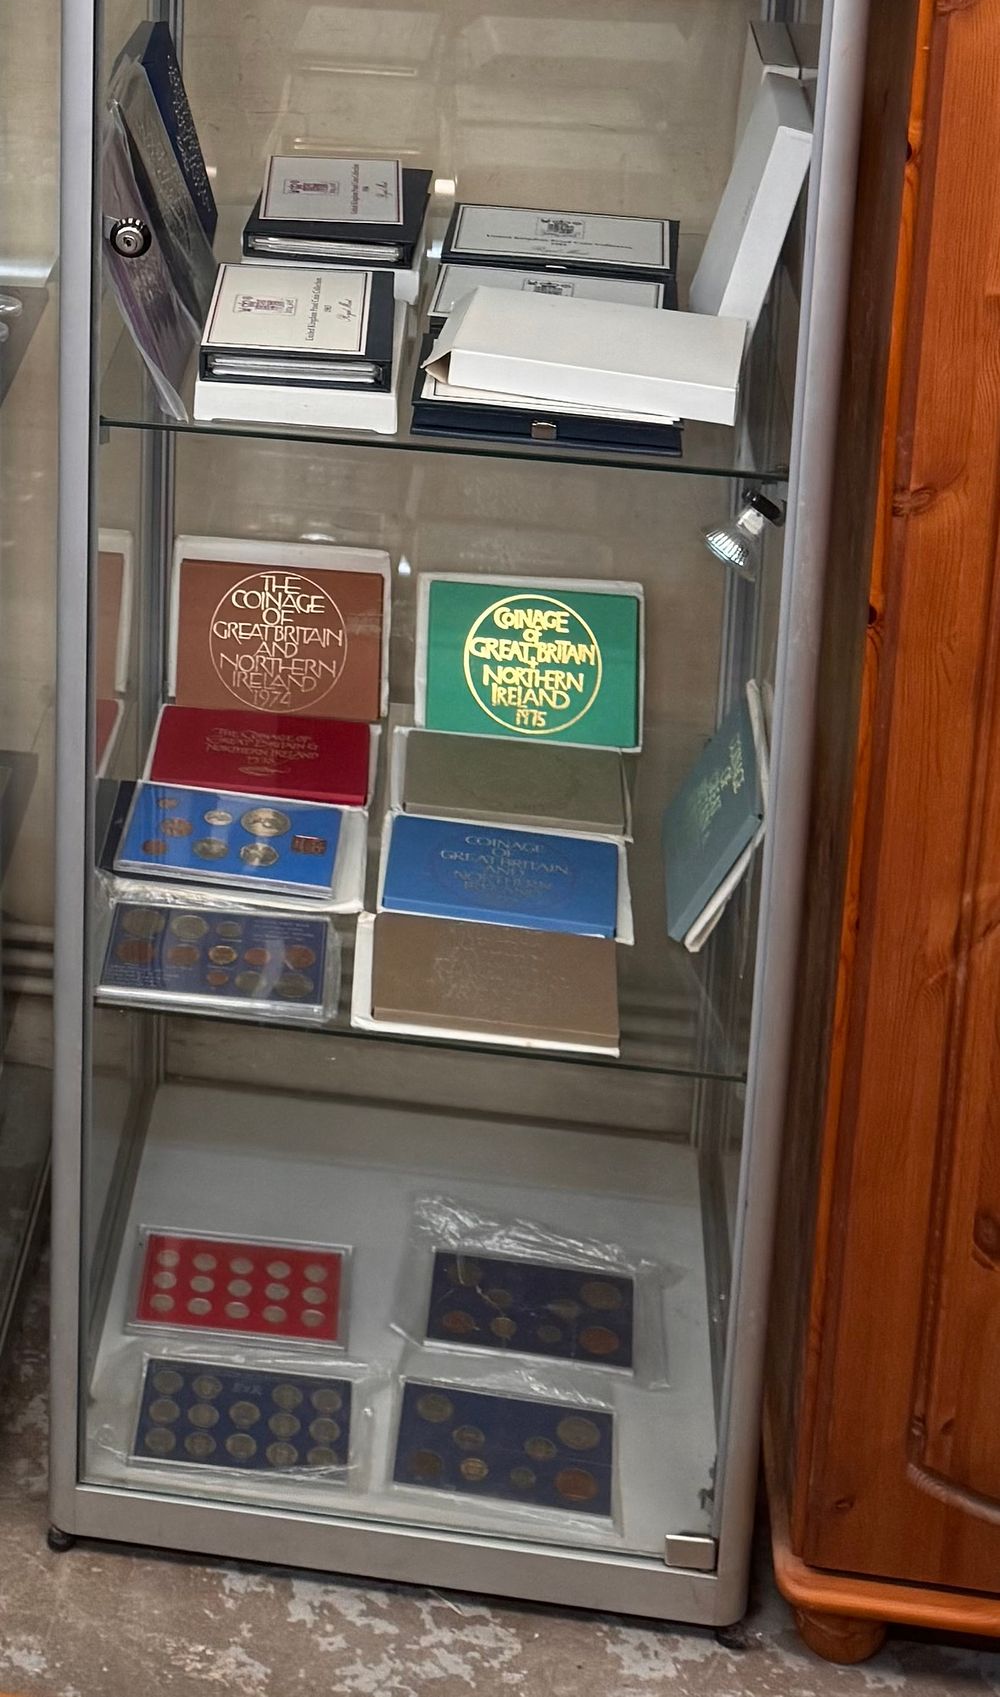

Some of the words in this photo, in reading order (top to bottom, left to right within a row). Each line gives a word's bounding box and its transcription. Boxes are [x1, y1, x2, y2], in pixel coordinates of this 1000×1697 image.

[260, 575, 301, 595] THE
[231, 590, 325, 613] COINAGE
[262, 608, 295, 625] OF
[493, 607, 570, 634] COINAGE
[523, 628, 542, 644] OF
[254, 642, 298, 658] AND
[468, 637, 537, 664] GREAT
[537, 640, 596, 665] BRITAIN
[220, 653, 336, 679] NORTHERN
[232, 670, 317, 693] IRELAND
[482, 664, 585, 693] NORTHERN
[253, 689, 291, 707] 1974
[491, 683, 571, 709] IRELAND
[516, 708, 548, 727] 1975
[464, 835, 545, 853] COINAGE
[500, 857, 569, 875] BRITAIN
